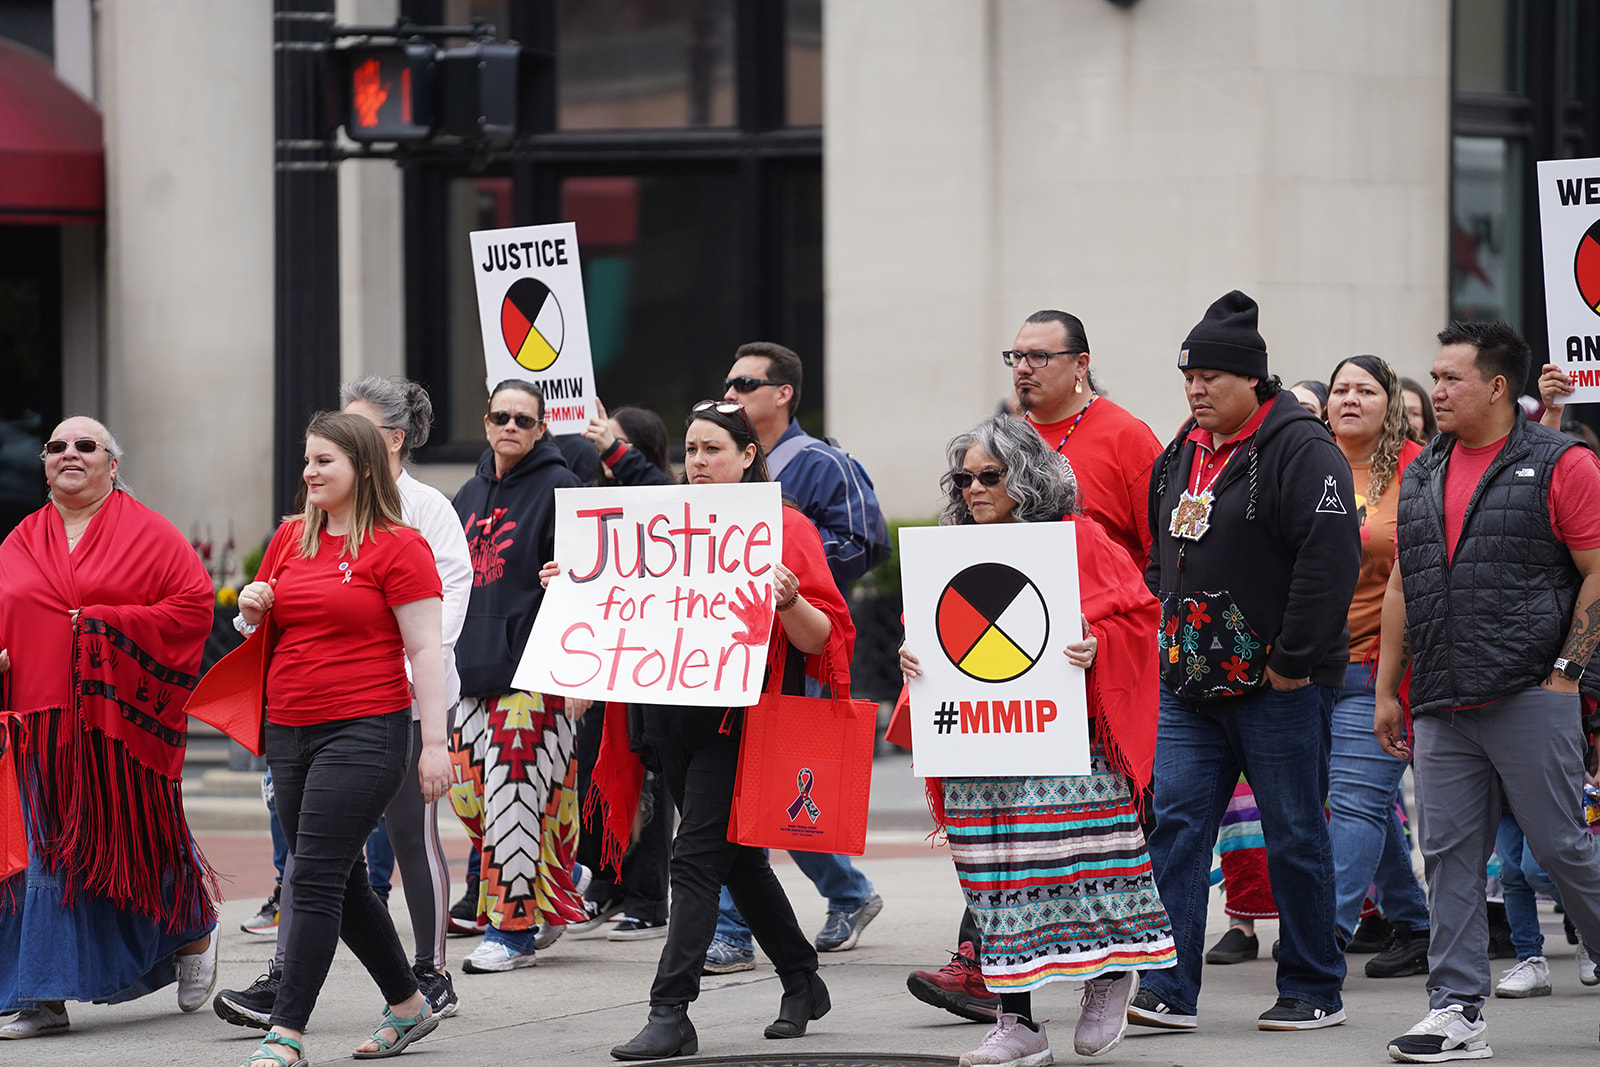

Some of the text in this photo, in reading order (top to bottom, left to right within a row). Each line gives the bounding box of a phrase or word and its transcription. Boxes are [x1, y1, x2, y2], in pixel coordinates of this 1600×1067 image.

[1556, 177, 1600, 206] WE
[482, 238, 568, 272] JUSTICE
[544, 405, 585, 422] #MMIW
[568, 502, 772, 584] Justice
[596, 586, 726, 621] for the
[549, 622, 751, 692] Stolen
[933, 699, 1058, 734] #MMIP
